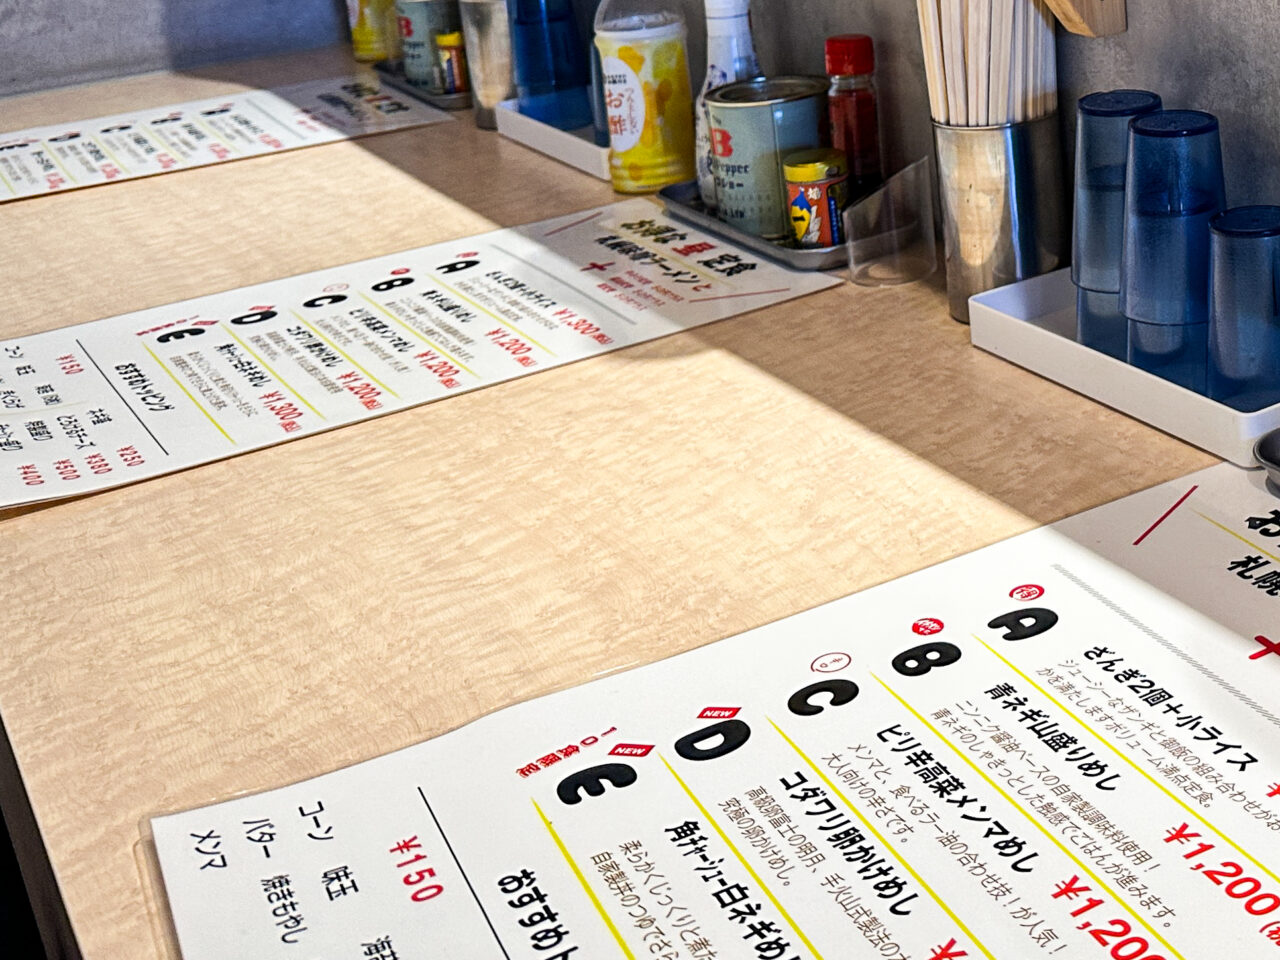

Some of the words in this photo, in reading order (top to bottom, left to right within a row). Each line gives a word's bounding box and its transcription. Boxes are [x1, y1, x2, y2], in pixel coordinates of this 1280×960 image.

[435, 259, 481, 274] A
[303, 294, 348, 308] C
[371, 278, 415, 292] B
[230, 311, 278, 325] D
[53, 458, 81, 481] ¥500
[84, 453, 113, 475] ¥380
[116, 444, 146, 467] ¥250
[17, 464, 45, 486] ¥400
[987, 607, 1059, 641] A
[891, 641, 962, 677] B
[702, 709, 733, 718] NEW
[787, 679, 859, 716] C
[614, 747, 646, 755] NEW
[674, 719, 751, 761] D
[984, 681, 1121, 793] 青ネギ山盛りめし
[556, 762, 638, 805] E
[876, 724, 1039, 874] ピリ辛高菜メンマめし
[242, 817, 277, 859] バター
[298, 800, 334, 841] コーン
[190, 829, 228, 871] メンマ
[779, 770, 919, 915] コダワリ卵かけめし
[321, 865, 359, 901] 味玉
[389, 835, 444, 903] ¥150
[664, 820, 800, 960] 角チャーシュー白ネギめ
[260, 874, 308, 944] 焼きもやし
[1051, 874, 1167, 960] ¥1,20
